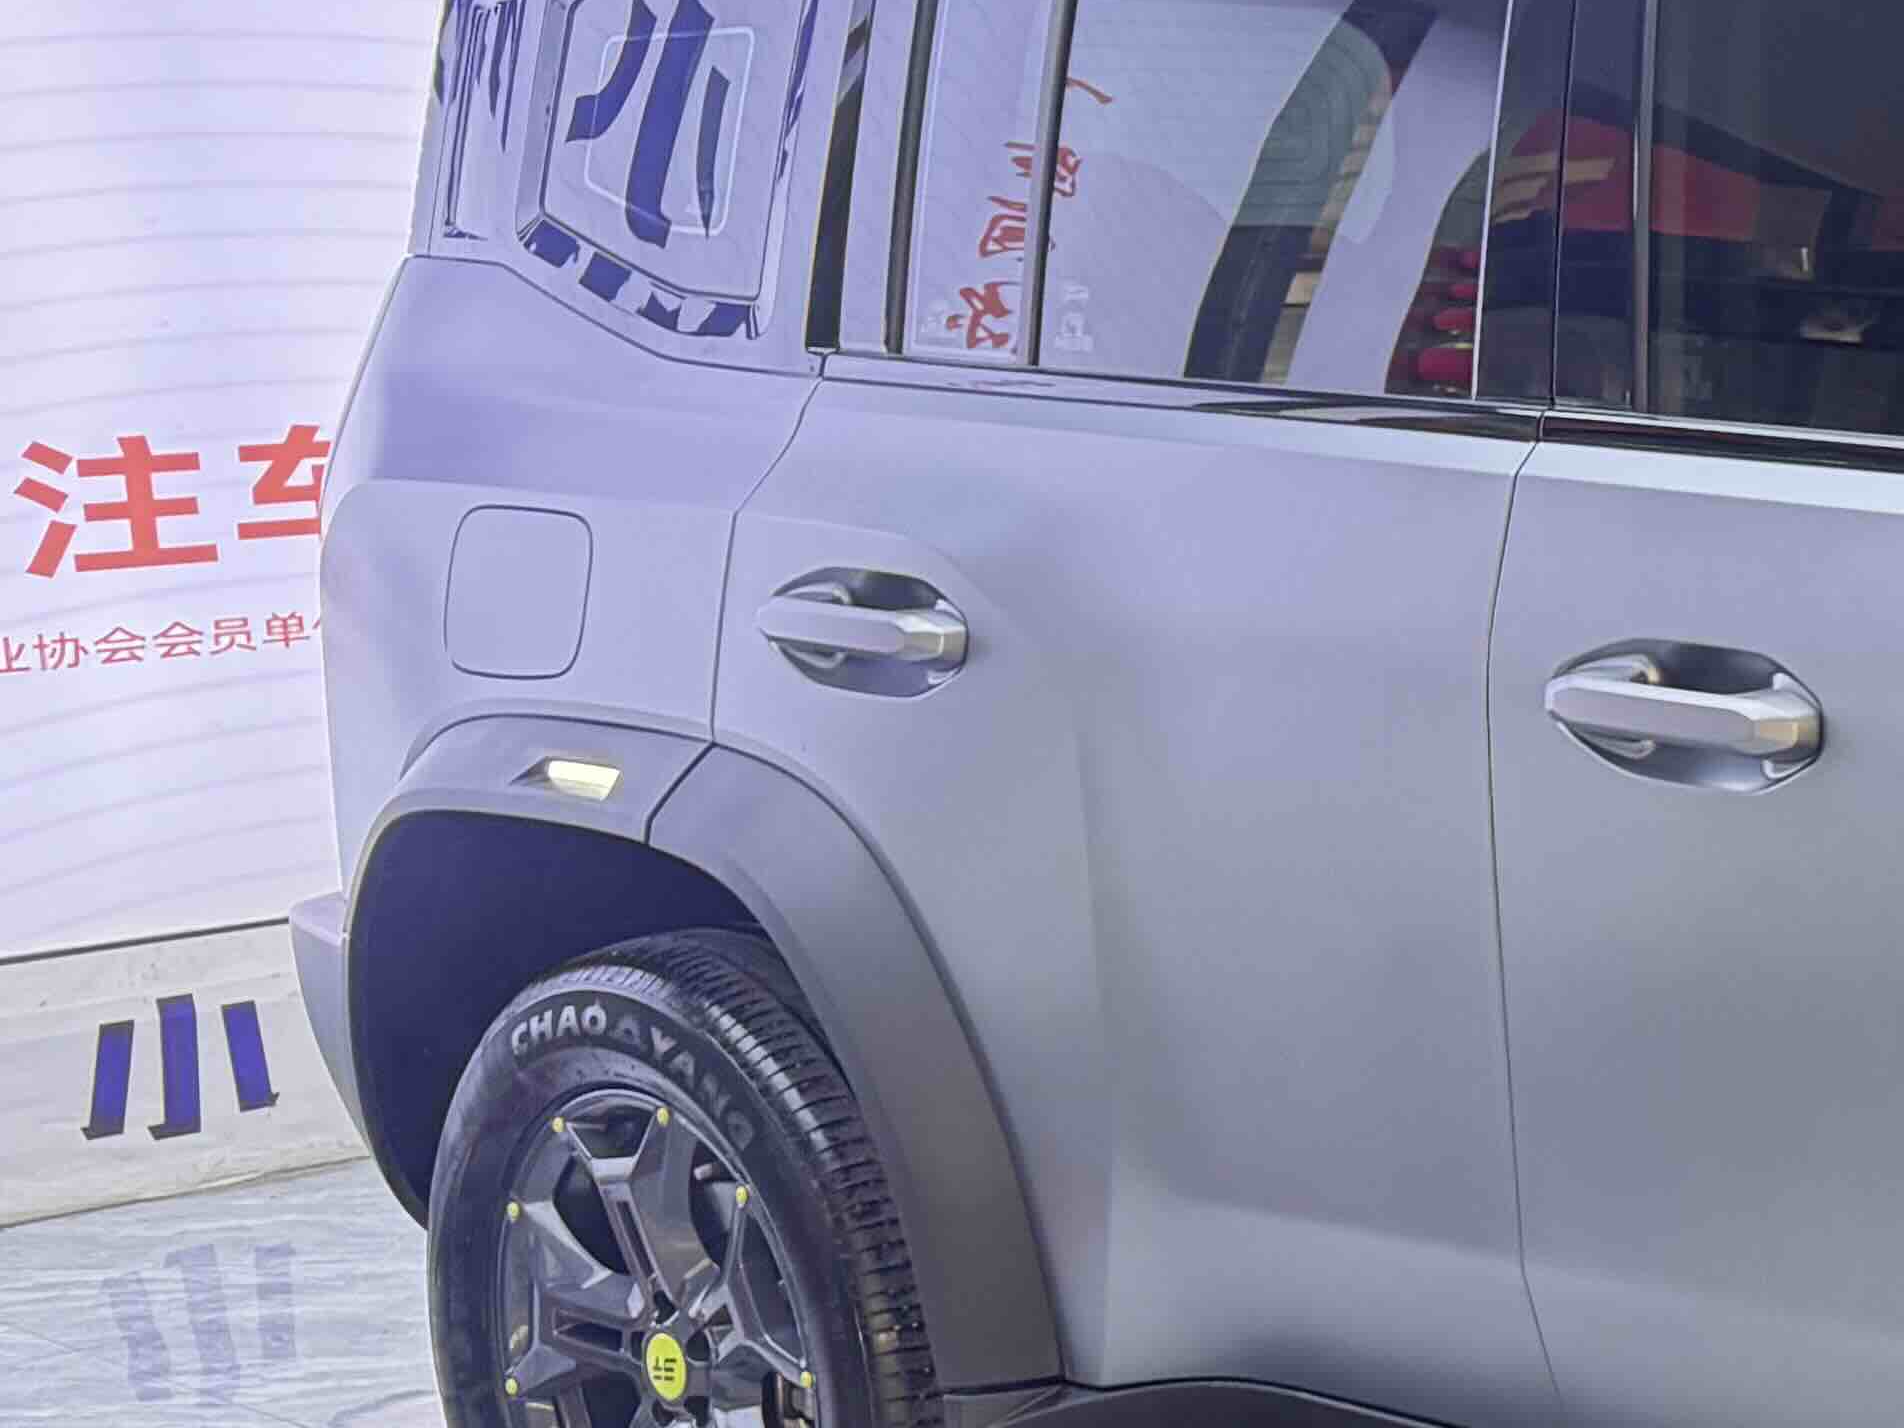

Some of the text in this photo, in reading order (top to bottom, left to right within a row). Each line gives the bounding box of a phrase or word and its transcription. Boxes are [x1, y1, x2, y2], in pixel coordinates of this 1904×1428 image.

[0, 610, 322, 673] 业协会会员单
[510, 1002, 608, 1058] CHAO
[82, 993, 281, 1141] 小
